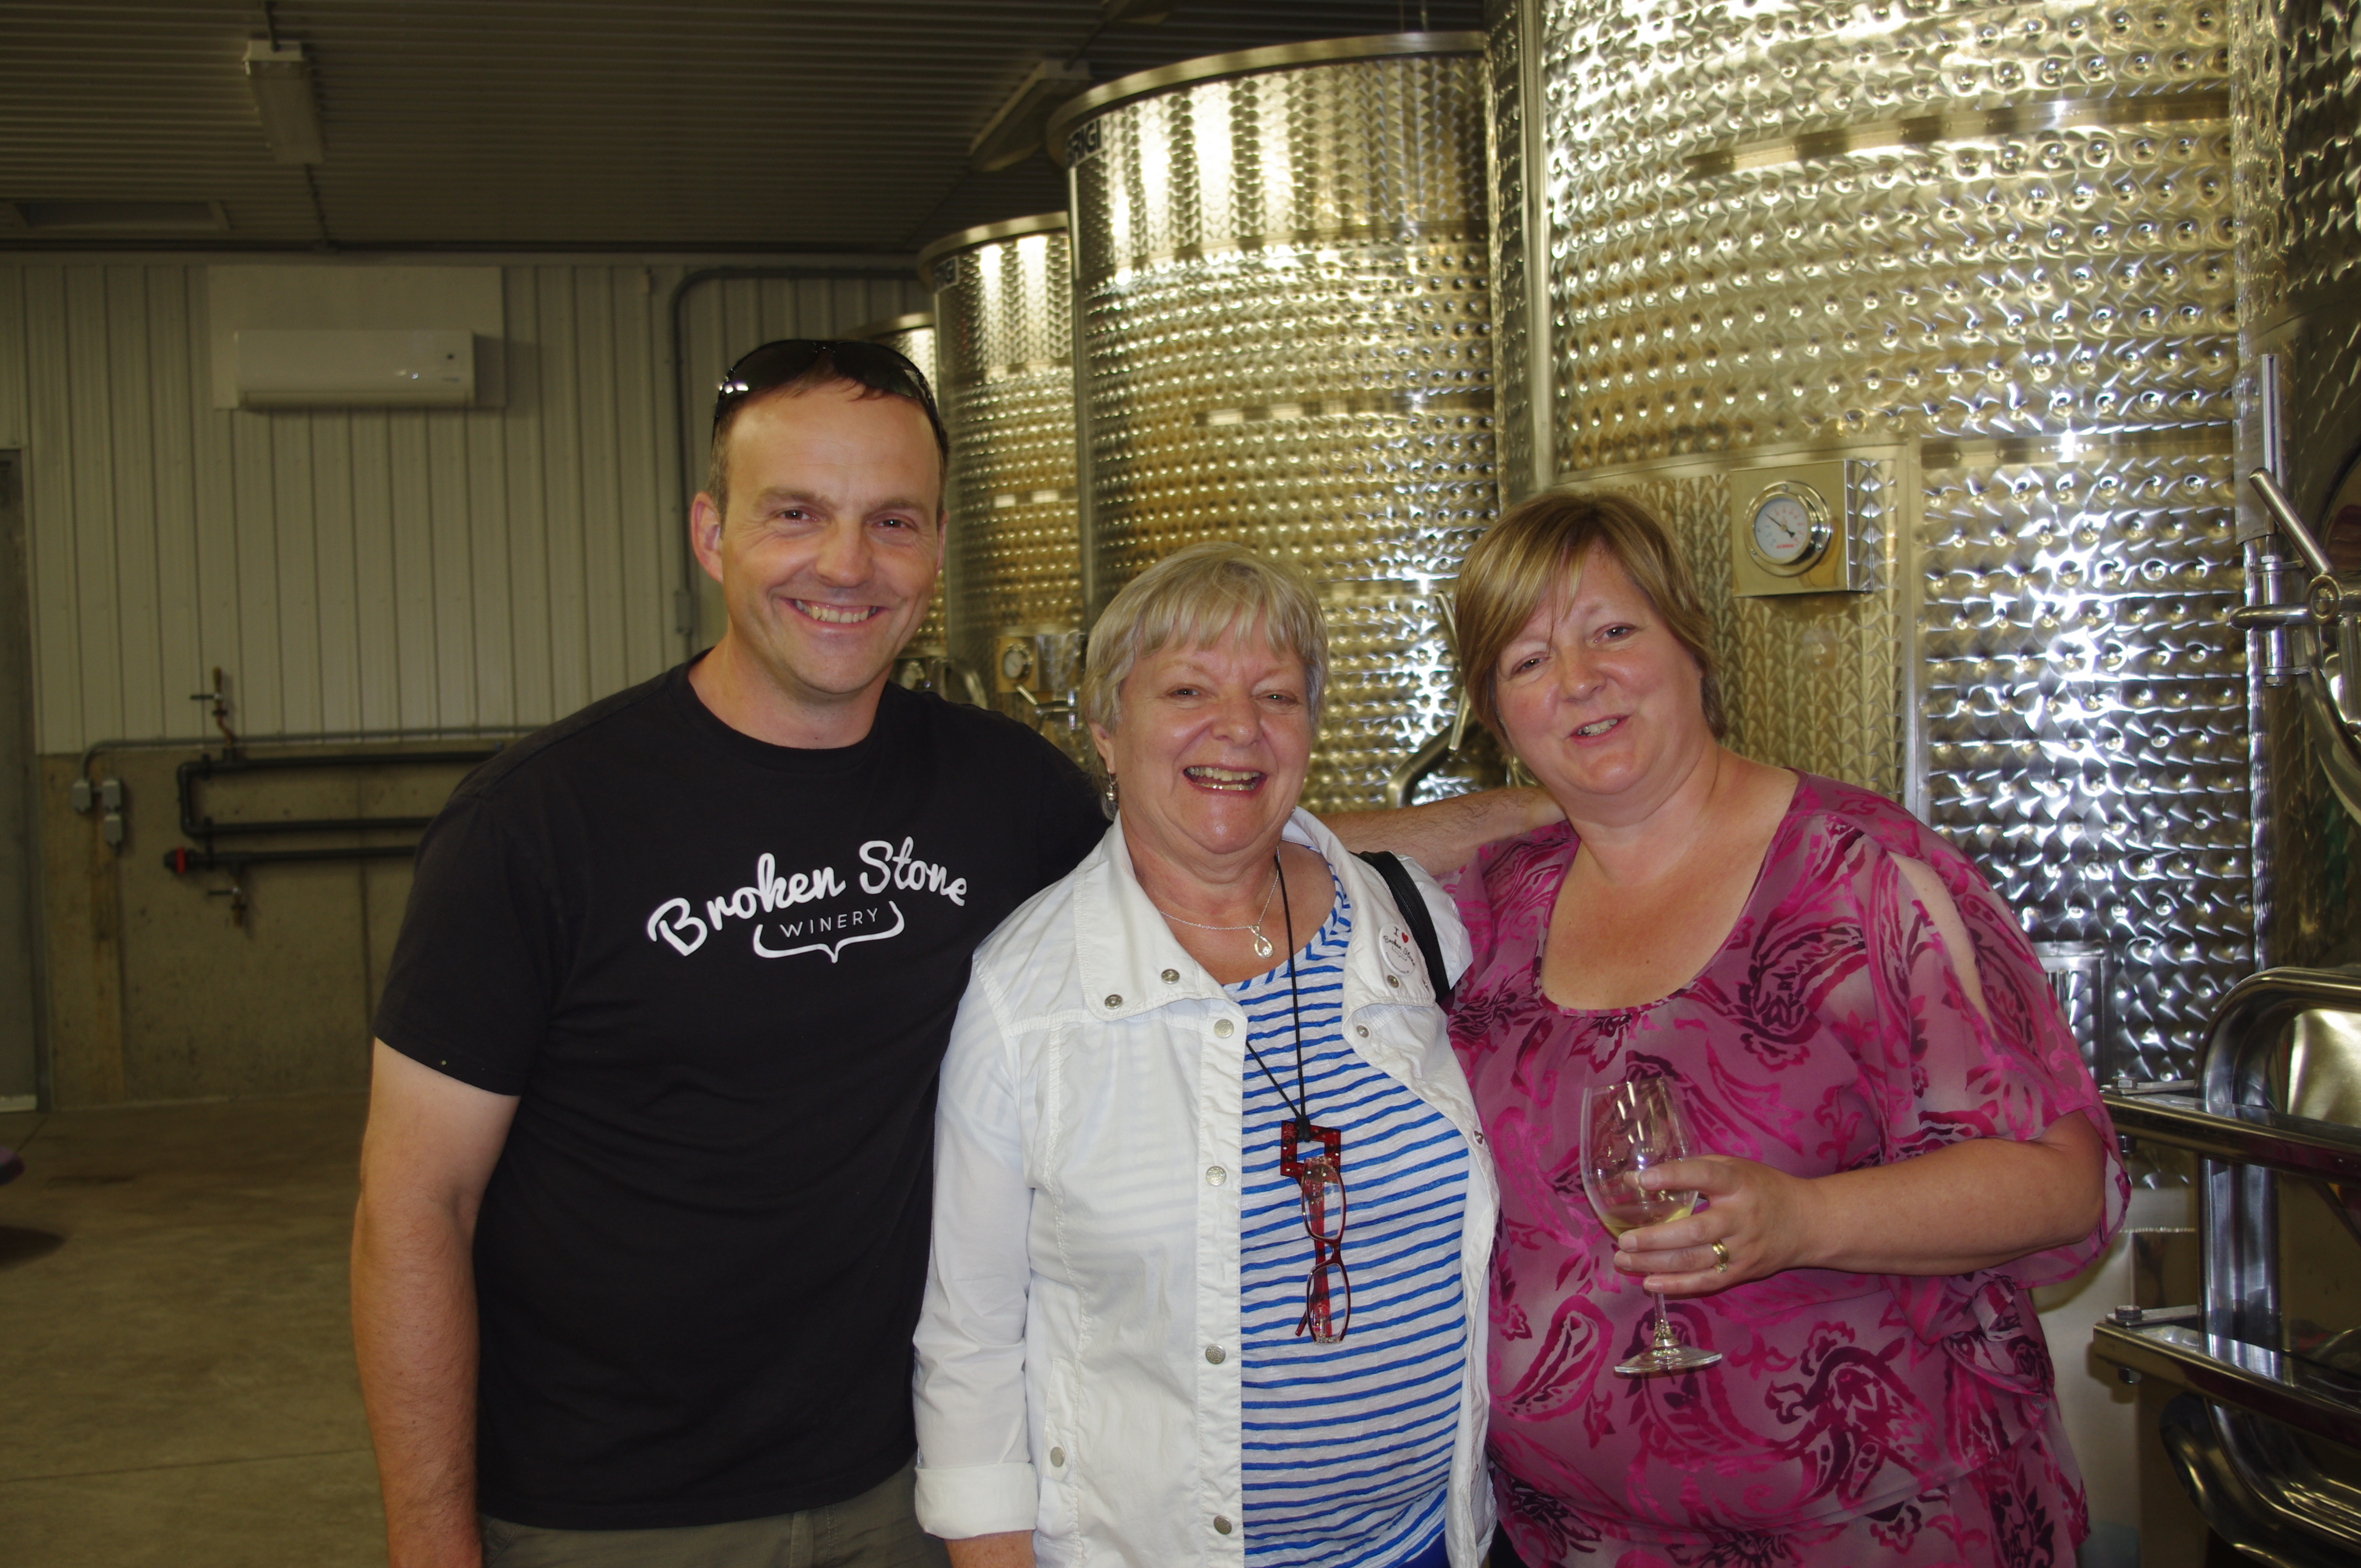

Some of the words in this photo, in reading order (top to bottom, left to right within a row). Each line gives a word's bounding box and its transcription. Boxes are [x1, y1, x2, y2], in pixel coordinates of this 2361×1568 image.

[647, 852, 846, 956] Broken
[858, 836, 967, 906] Stone
[780, 907, 878, 938] WINERY
[1394, 926, 1399, 937] I
[1383, 935, 1402, 951] Broken
[1403, 947, 1416, 967] Stone
